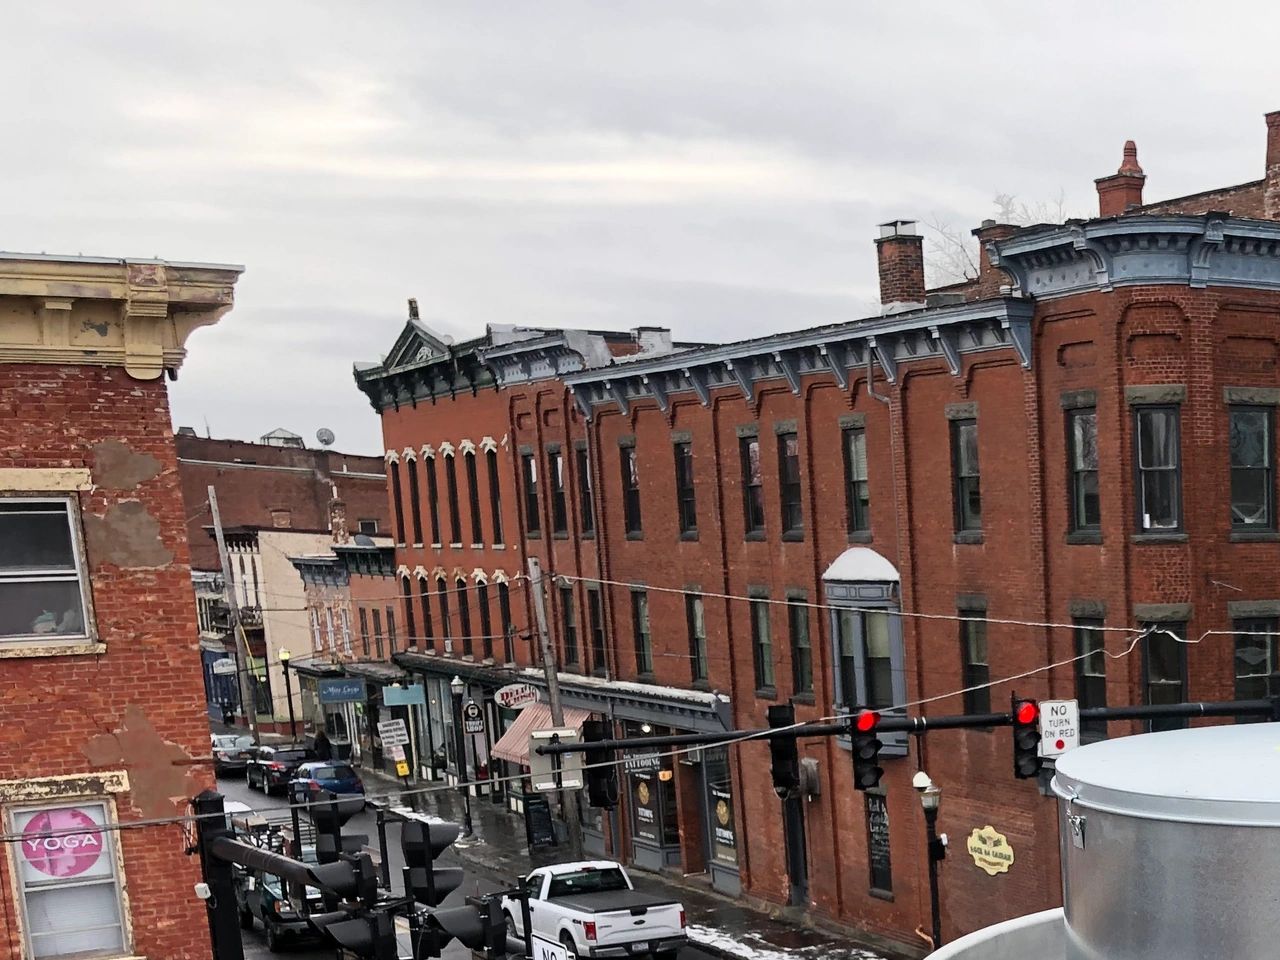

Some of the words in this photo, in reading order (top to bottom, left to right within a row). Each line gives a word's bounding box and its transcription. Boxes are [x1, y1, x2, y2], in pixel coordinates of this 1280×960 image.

[1051, 705, 1067, 716] NO
[1048, 719, 1071, 728] TURN
[1044, 730, 1056, 738] ON
[1060, 728, 1076, 738] RED
[28, 834, 98, 851] YOGA
